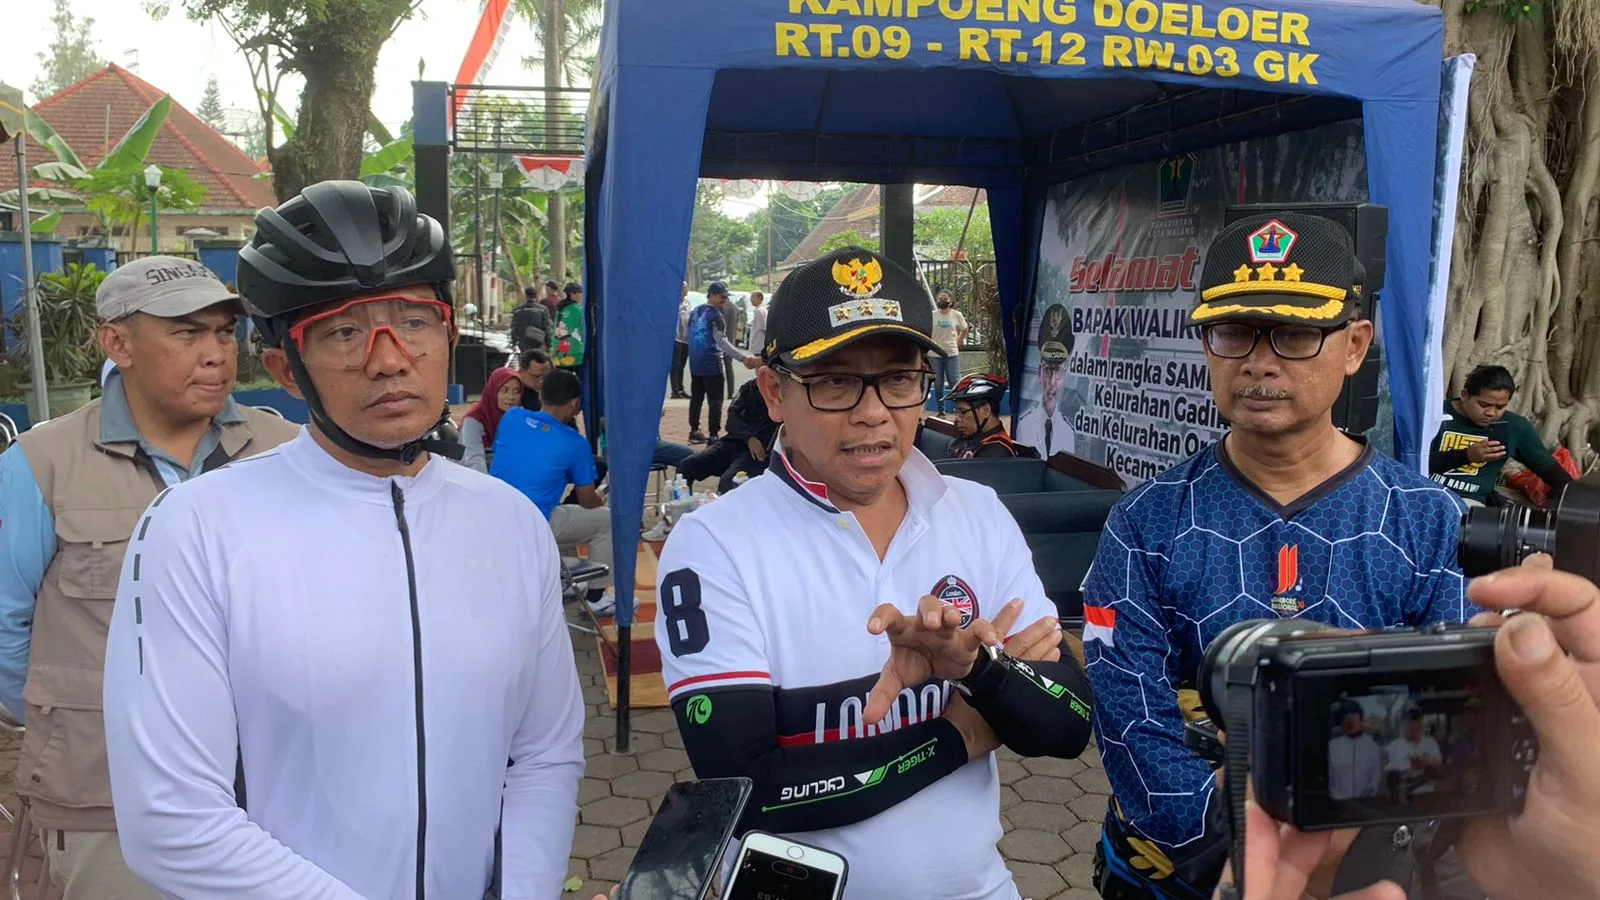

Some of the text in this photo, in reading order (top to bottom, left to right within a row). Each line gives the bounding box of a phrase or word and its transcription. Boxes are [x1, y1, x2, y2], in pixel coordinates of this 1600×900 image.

[1093, 0, 1310, 46] DOELOER
[775, 22, 1319, 84] RT.09 - RT.12 RW.03 GK
[1070, 246, 1199, 292] Selamat
[1073, 308, 1126, 336] BAPAK
[1069, 352, 1107, 377] dalam
[1110, 358, 1161, 387] rangka
[1094, 384, 1170, 419] Kelurahan
[1075, 409, 1099, 436] dan
[1102, 414, 1181, 455] Kelurahan
[1106, 446, 1173, 480] Kecama
[660, 567, 710, 658] 8
